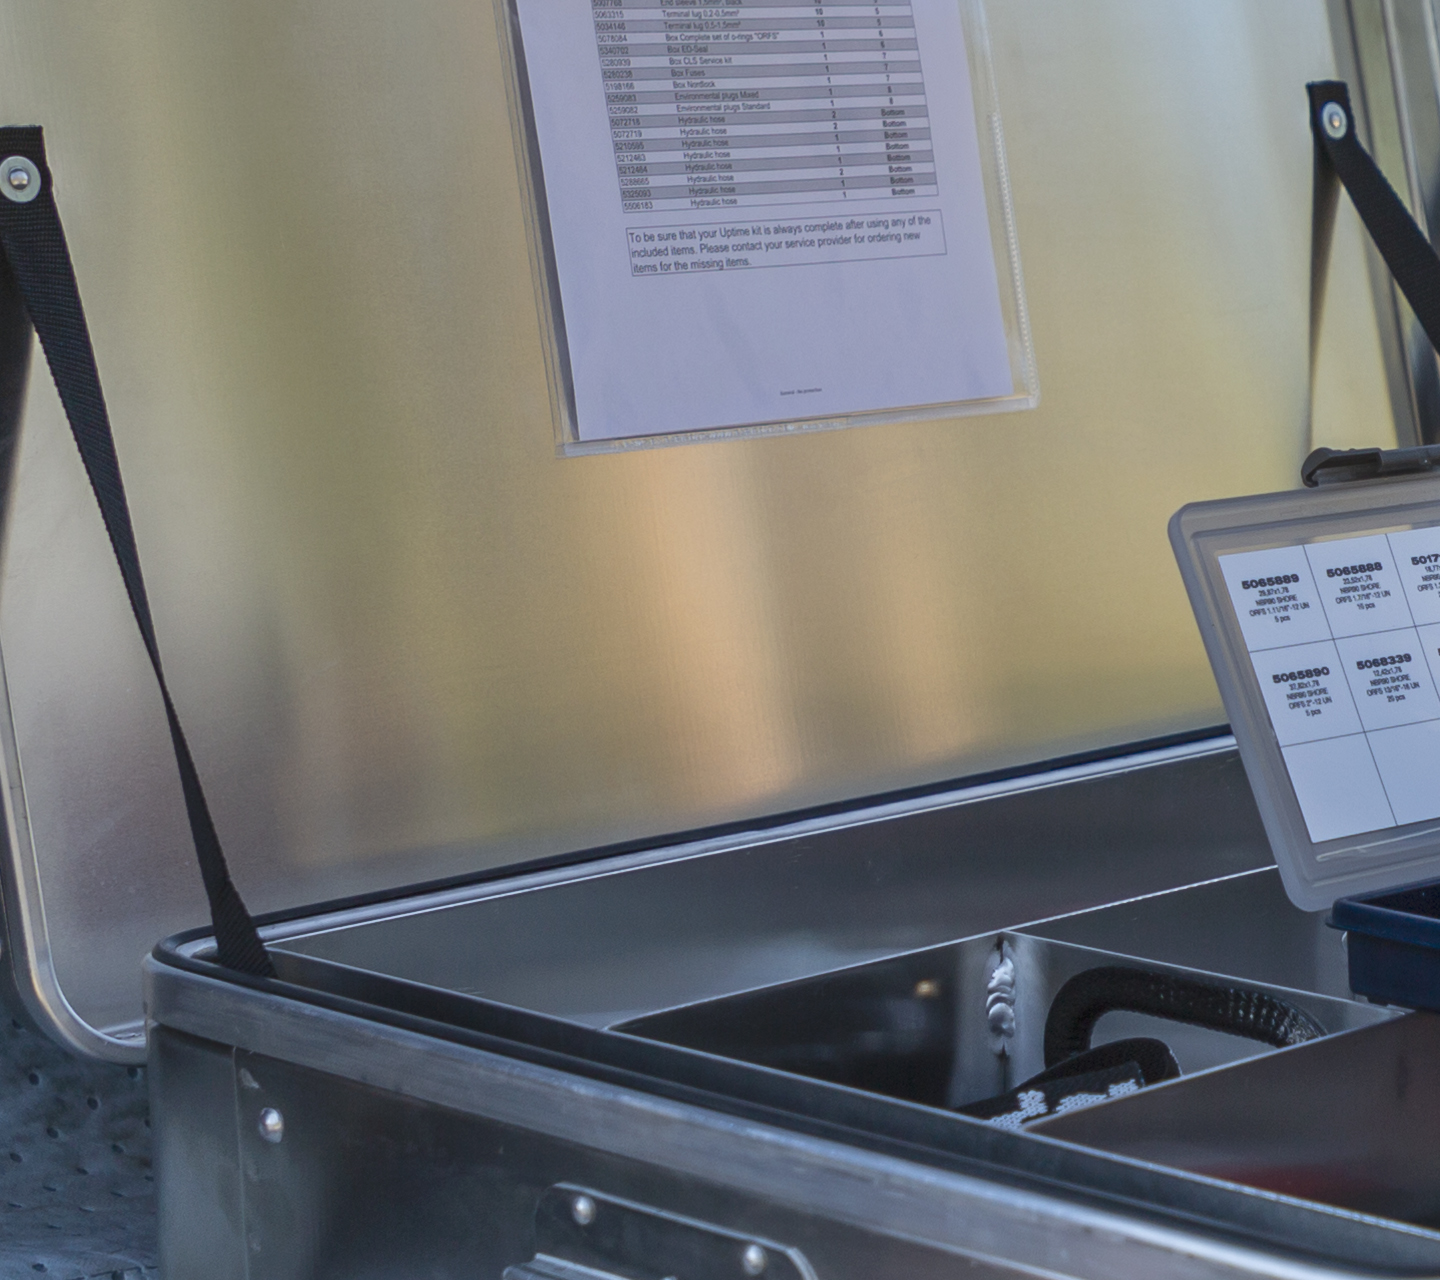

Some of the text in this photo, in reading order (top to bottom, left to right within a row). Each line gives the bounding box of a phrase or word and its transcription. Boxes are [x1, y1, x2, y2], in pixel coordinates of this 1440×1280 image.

[679, 128, 710, 138] Hydraulic
[882, 120, 906, 128] Bottom
[683, 151, 714, 161] Hydraulic
[885, 142, 909, 150] Bottom
[687, 175, 717, 185] Hydraulic
[888, 165, 912, 173] Bottom
[690, 198, 721, 208] Hydraulic
[891, 188, 915, 196] Bottom
[628, 232, 642, 243] To
[643, 232, 655, 243] be
[657, 232, 677, 242] sure
[678, 230, 697, 240] that
[698, 230, 717, 242] your
[719, 227, 750, 239] Uptime
[751, 226, 762, 235] kit
[773, 224, 803, 236] always
[804, 221, 843, 233] complete
[845, 219, 864, 230] after
[866, 219, 889, 230] using
[891, 219, 906, 229] any
[917, 216, 931, 225] the
[631, 232, 920, 258] included items. Please contact your service provider for ordering new
[633, 258, 752, 273] items for the missing items.
[1326, 562, 1383, 578] 5065888
[1242, 574, 1299, 590] 5065889
[1279, 615, 1291, 623] pcs
[1356, 653, 1412, 670] 5068339
[1272, 666, 1330, 684] 5065890
[1395, 694, 1406, 702] pcs
[1310, 709, 1322, 717] pcs
